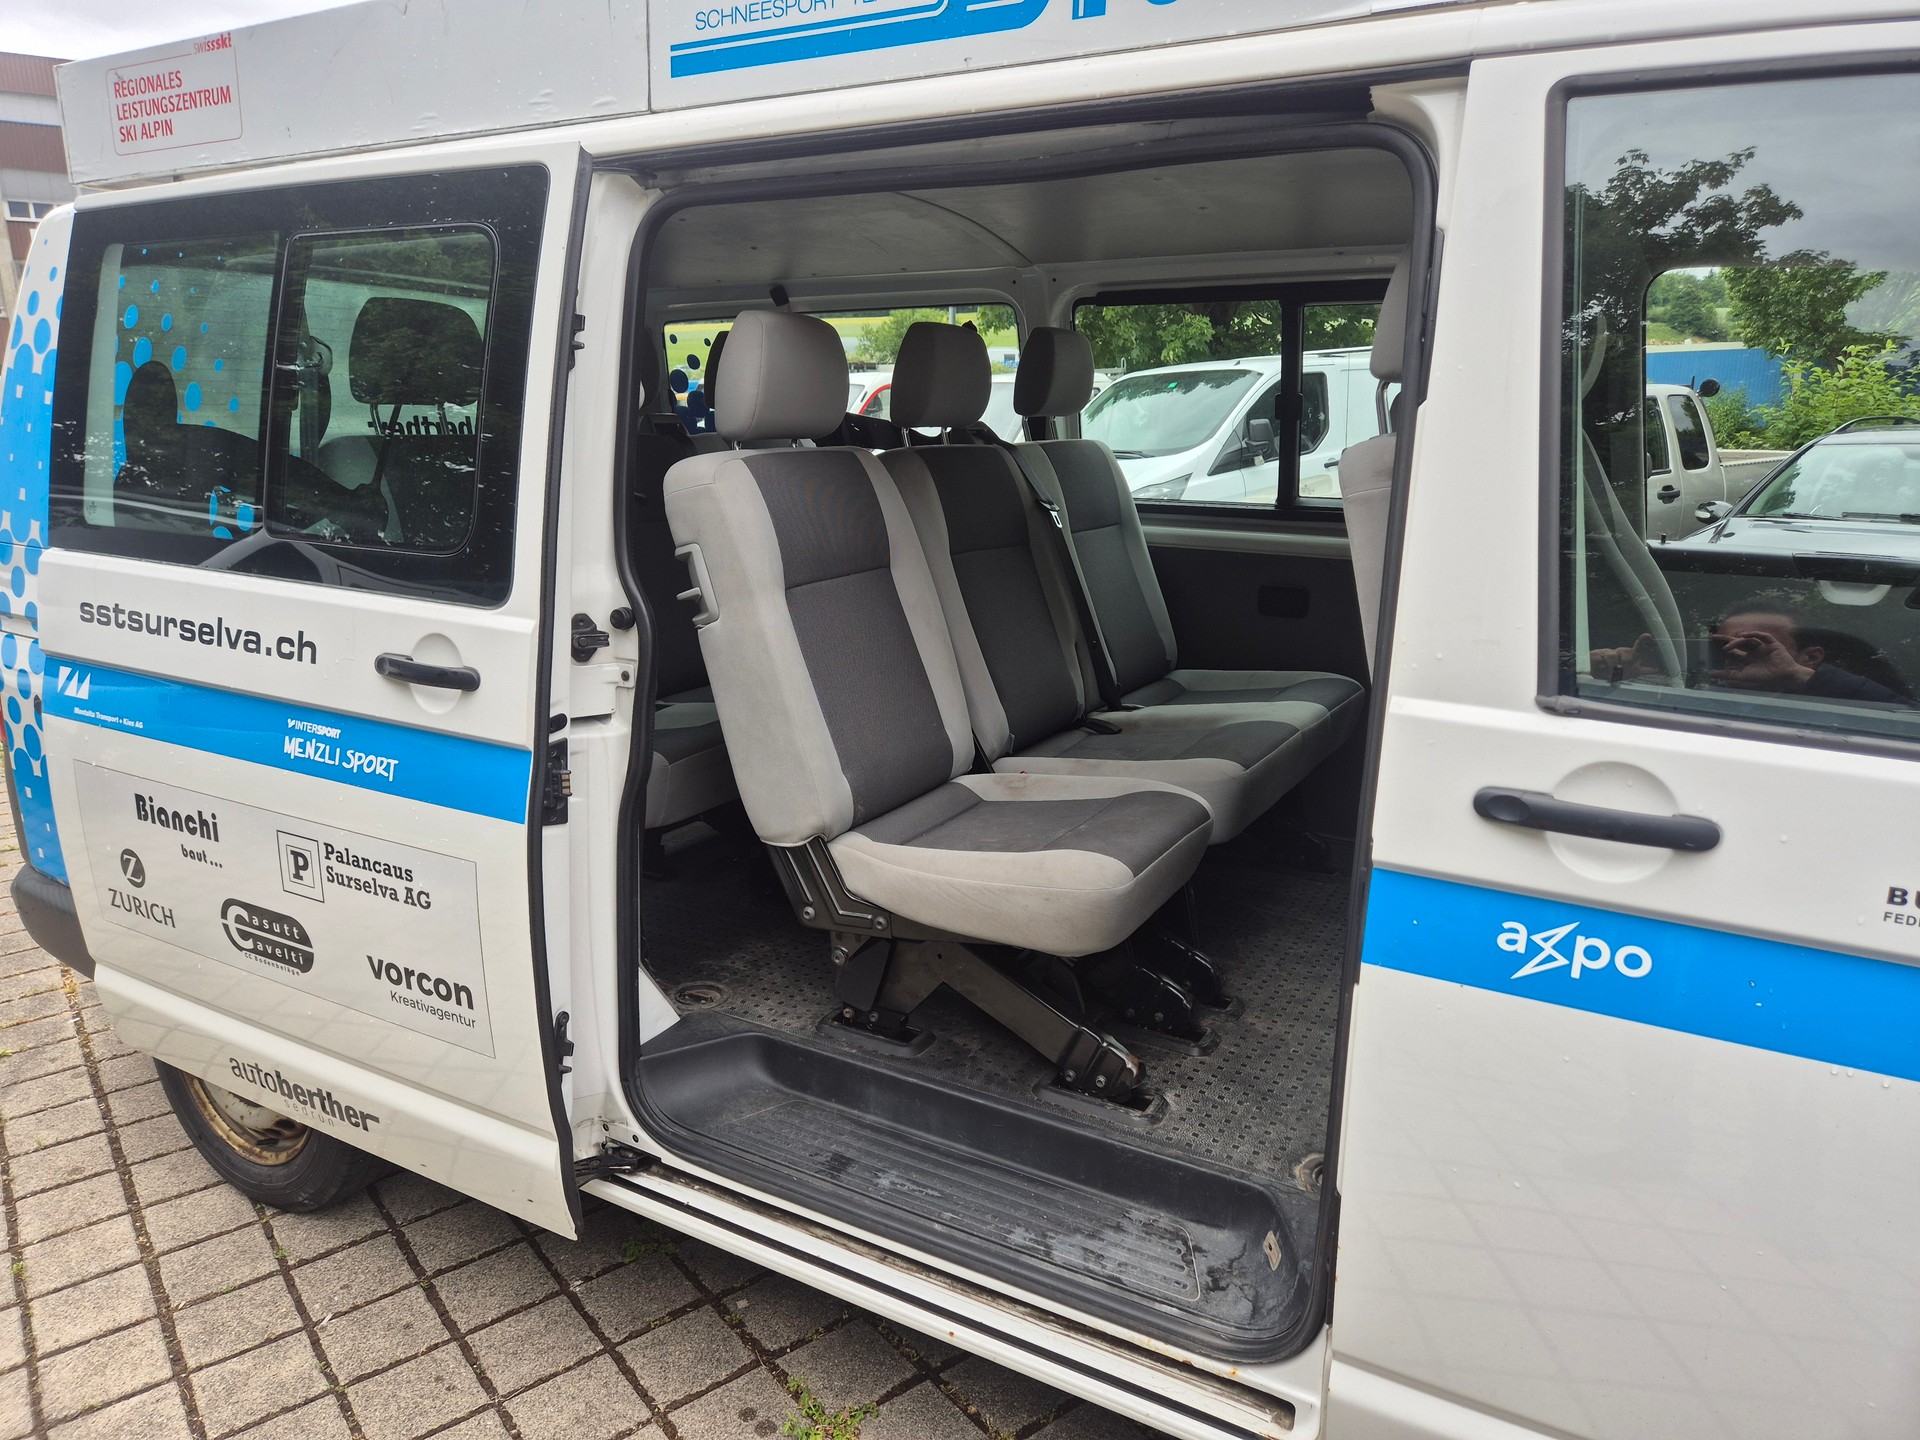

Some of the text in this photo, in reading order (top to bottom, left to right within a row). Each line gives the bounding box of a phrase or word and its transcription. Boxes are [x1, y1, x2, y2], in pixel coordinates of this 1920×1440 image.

[114, 70, 183, 99] REGIONALES
[116, 85, 232, 121] LEISTUNGSZENTRUM
[119, 119, 173, 143] SKI ALPIN
[80, 601, 317, 665] sstsurselva.ch
[295, 720, 341, 739] INTERSPORT
[284, 735, 399, 782] MENZLI SPORT
[134, 793, 220, 843] Bianchi
[289, 849, 309, 881] P
[323, 842, 414, 882] Palancaus
[326, 865, 432, 910] Surselva AG
[1886, 886, 1920, 910] B
[108, 887, 176, 929] ZURICH
[366, 955, 474, 1010] vorcon
[390, 990, 476, 1028] Kreativagentur
[229, 1057, 380, 1133] autoberther
